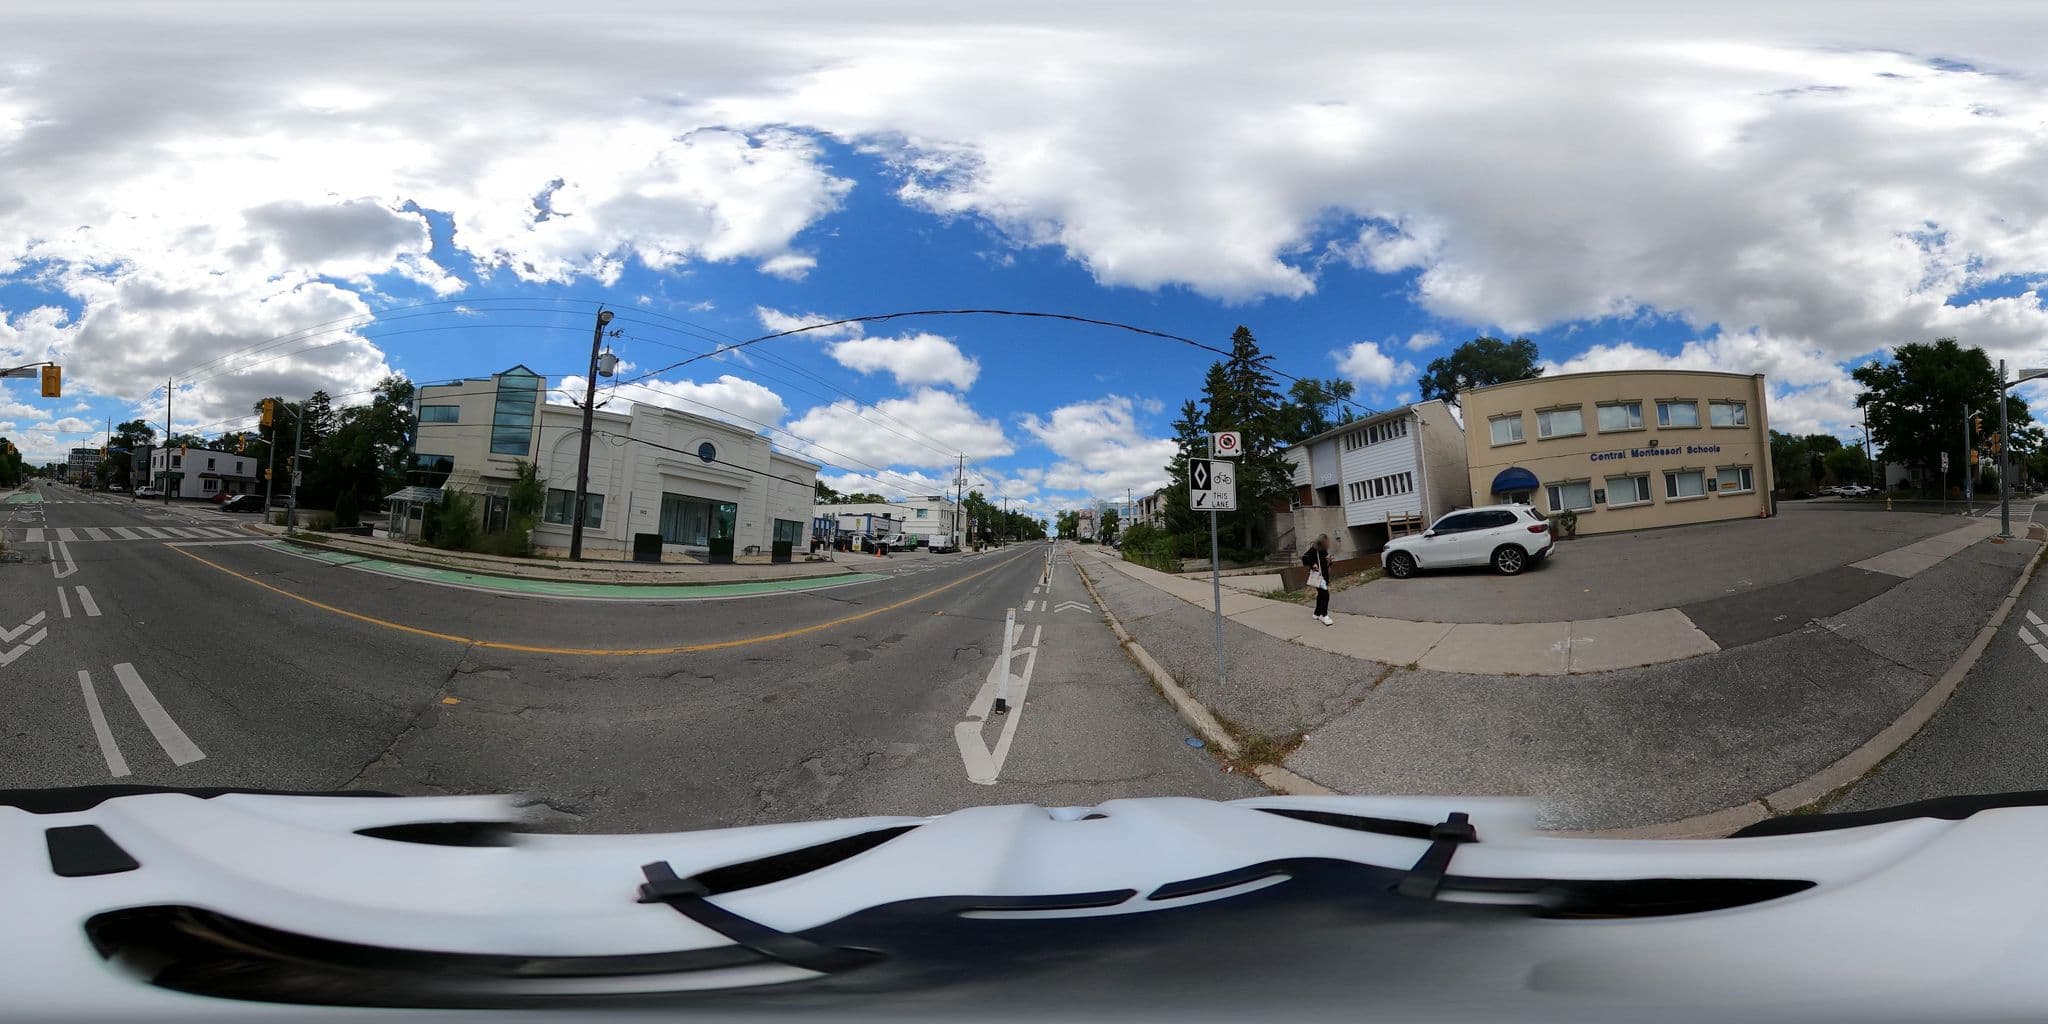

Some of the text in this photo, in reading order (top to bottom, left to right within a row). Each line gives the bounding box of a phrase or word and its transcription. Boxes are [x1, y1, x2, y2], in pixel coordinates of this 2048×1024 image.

[1590, 445, 1720, 461] Central Montessori Schools
[1213, 492, 1228, 500] THIS
